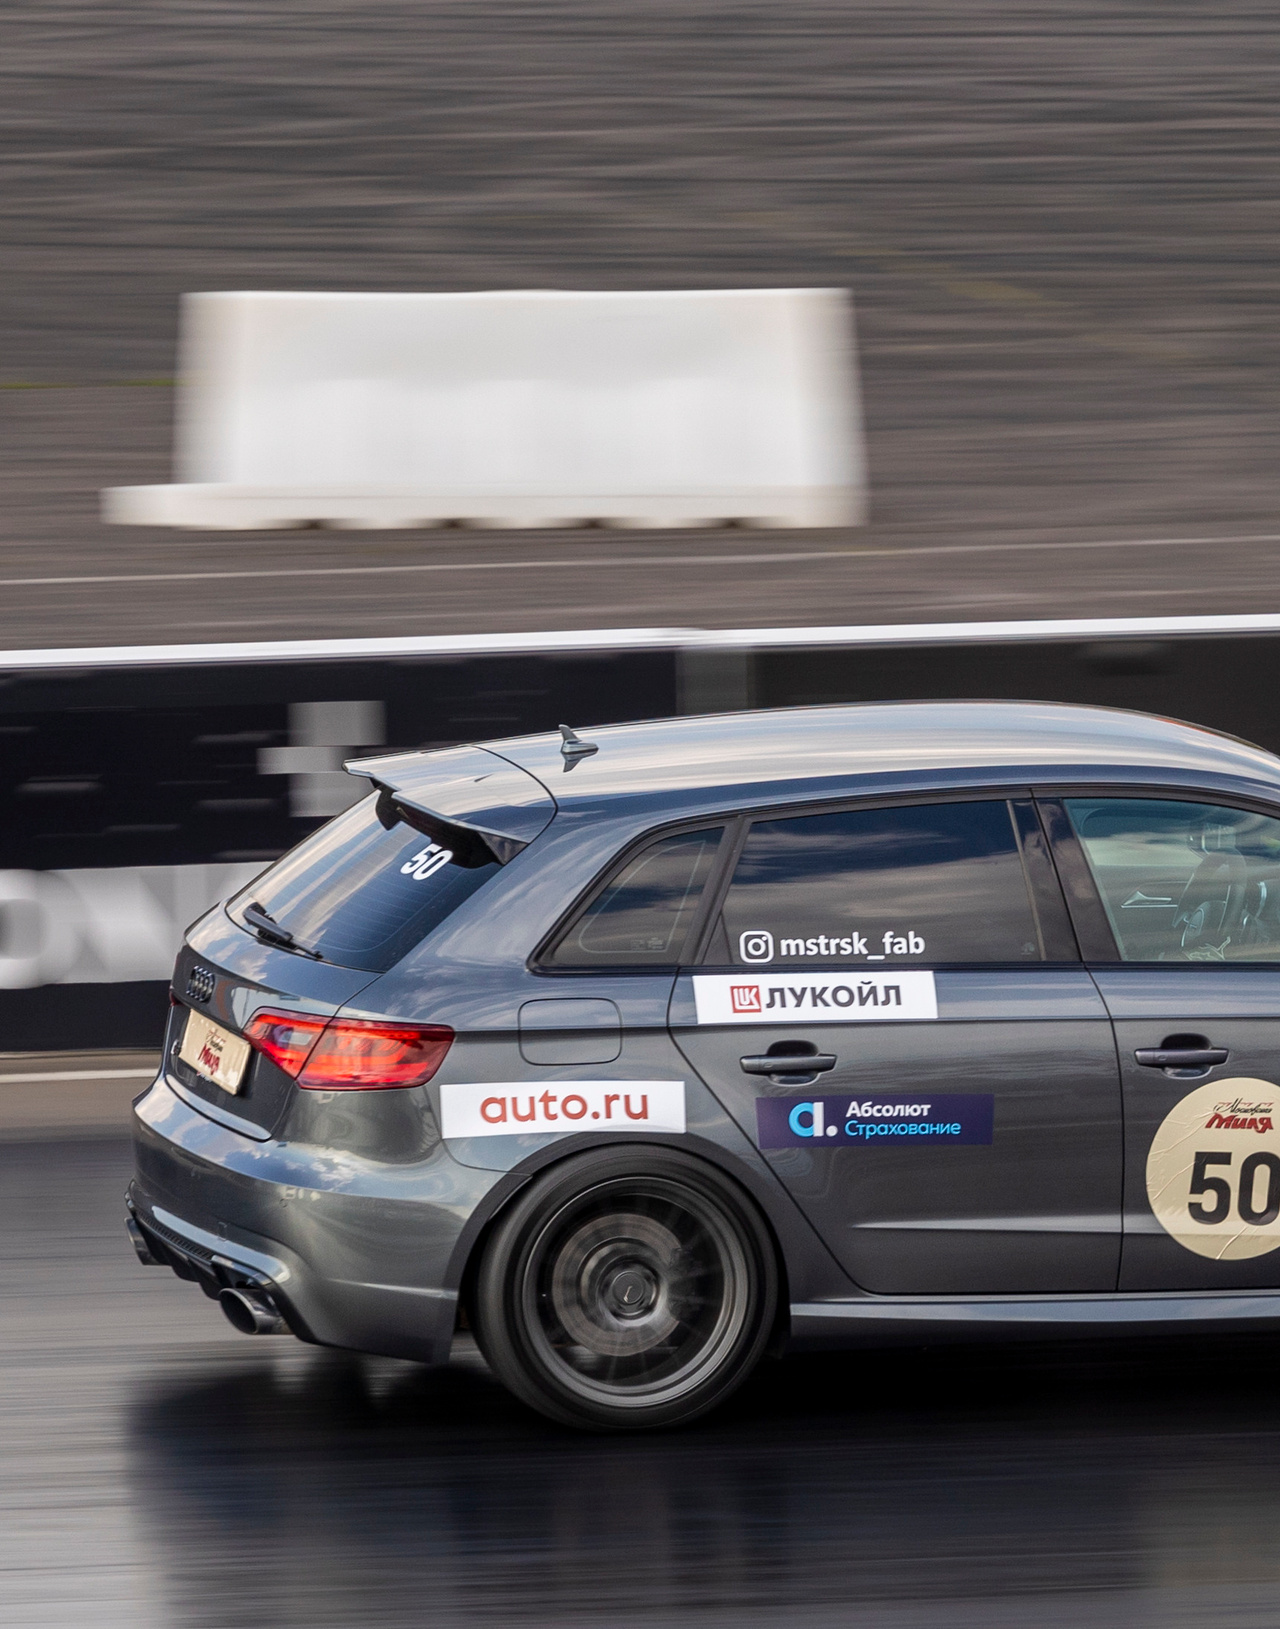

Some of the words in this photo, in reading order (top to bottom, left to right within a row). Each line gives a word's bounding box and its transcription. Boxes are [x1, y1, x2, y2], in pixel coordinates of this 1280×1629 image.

[400, 843, 453, 881] 50
[780, 930, 926, 961] mstrsk_fab
[766, 980, 902, 1009] ЛУКОЙЛ
[480, 1091, 648, 1124] auto.ru
[845, 1100, 932, 1118] Абсолют
[844, 1119, 962, 1140] Страхование
[1205, 1112, 1274, 1134] Миля
